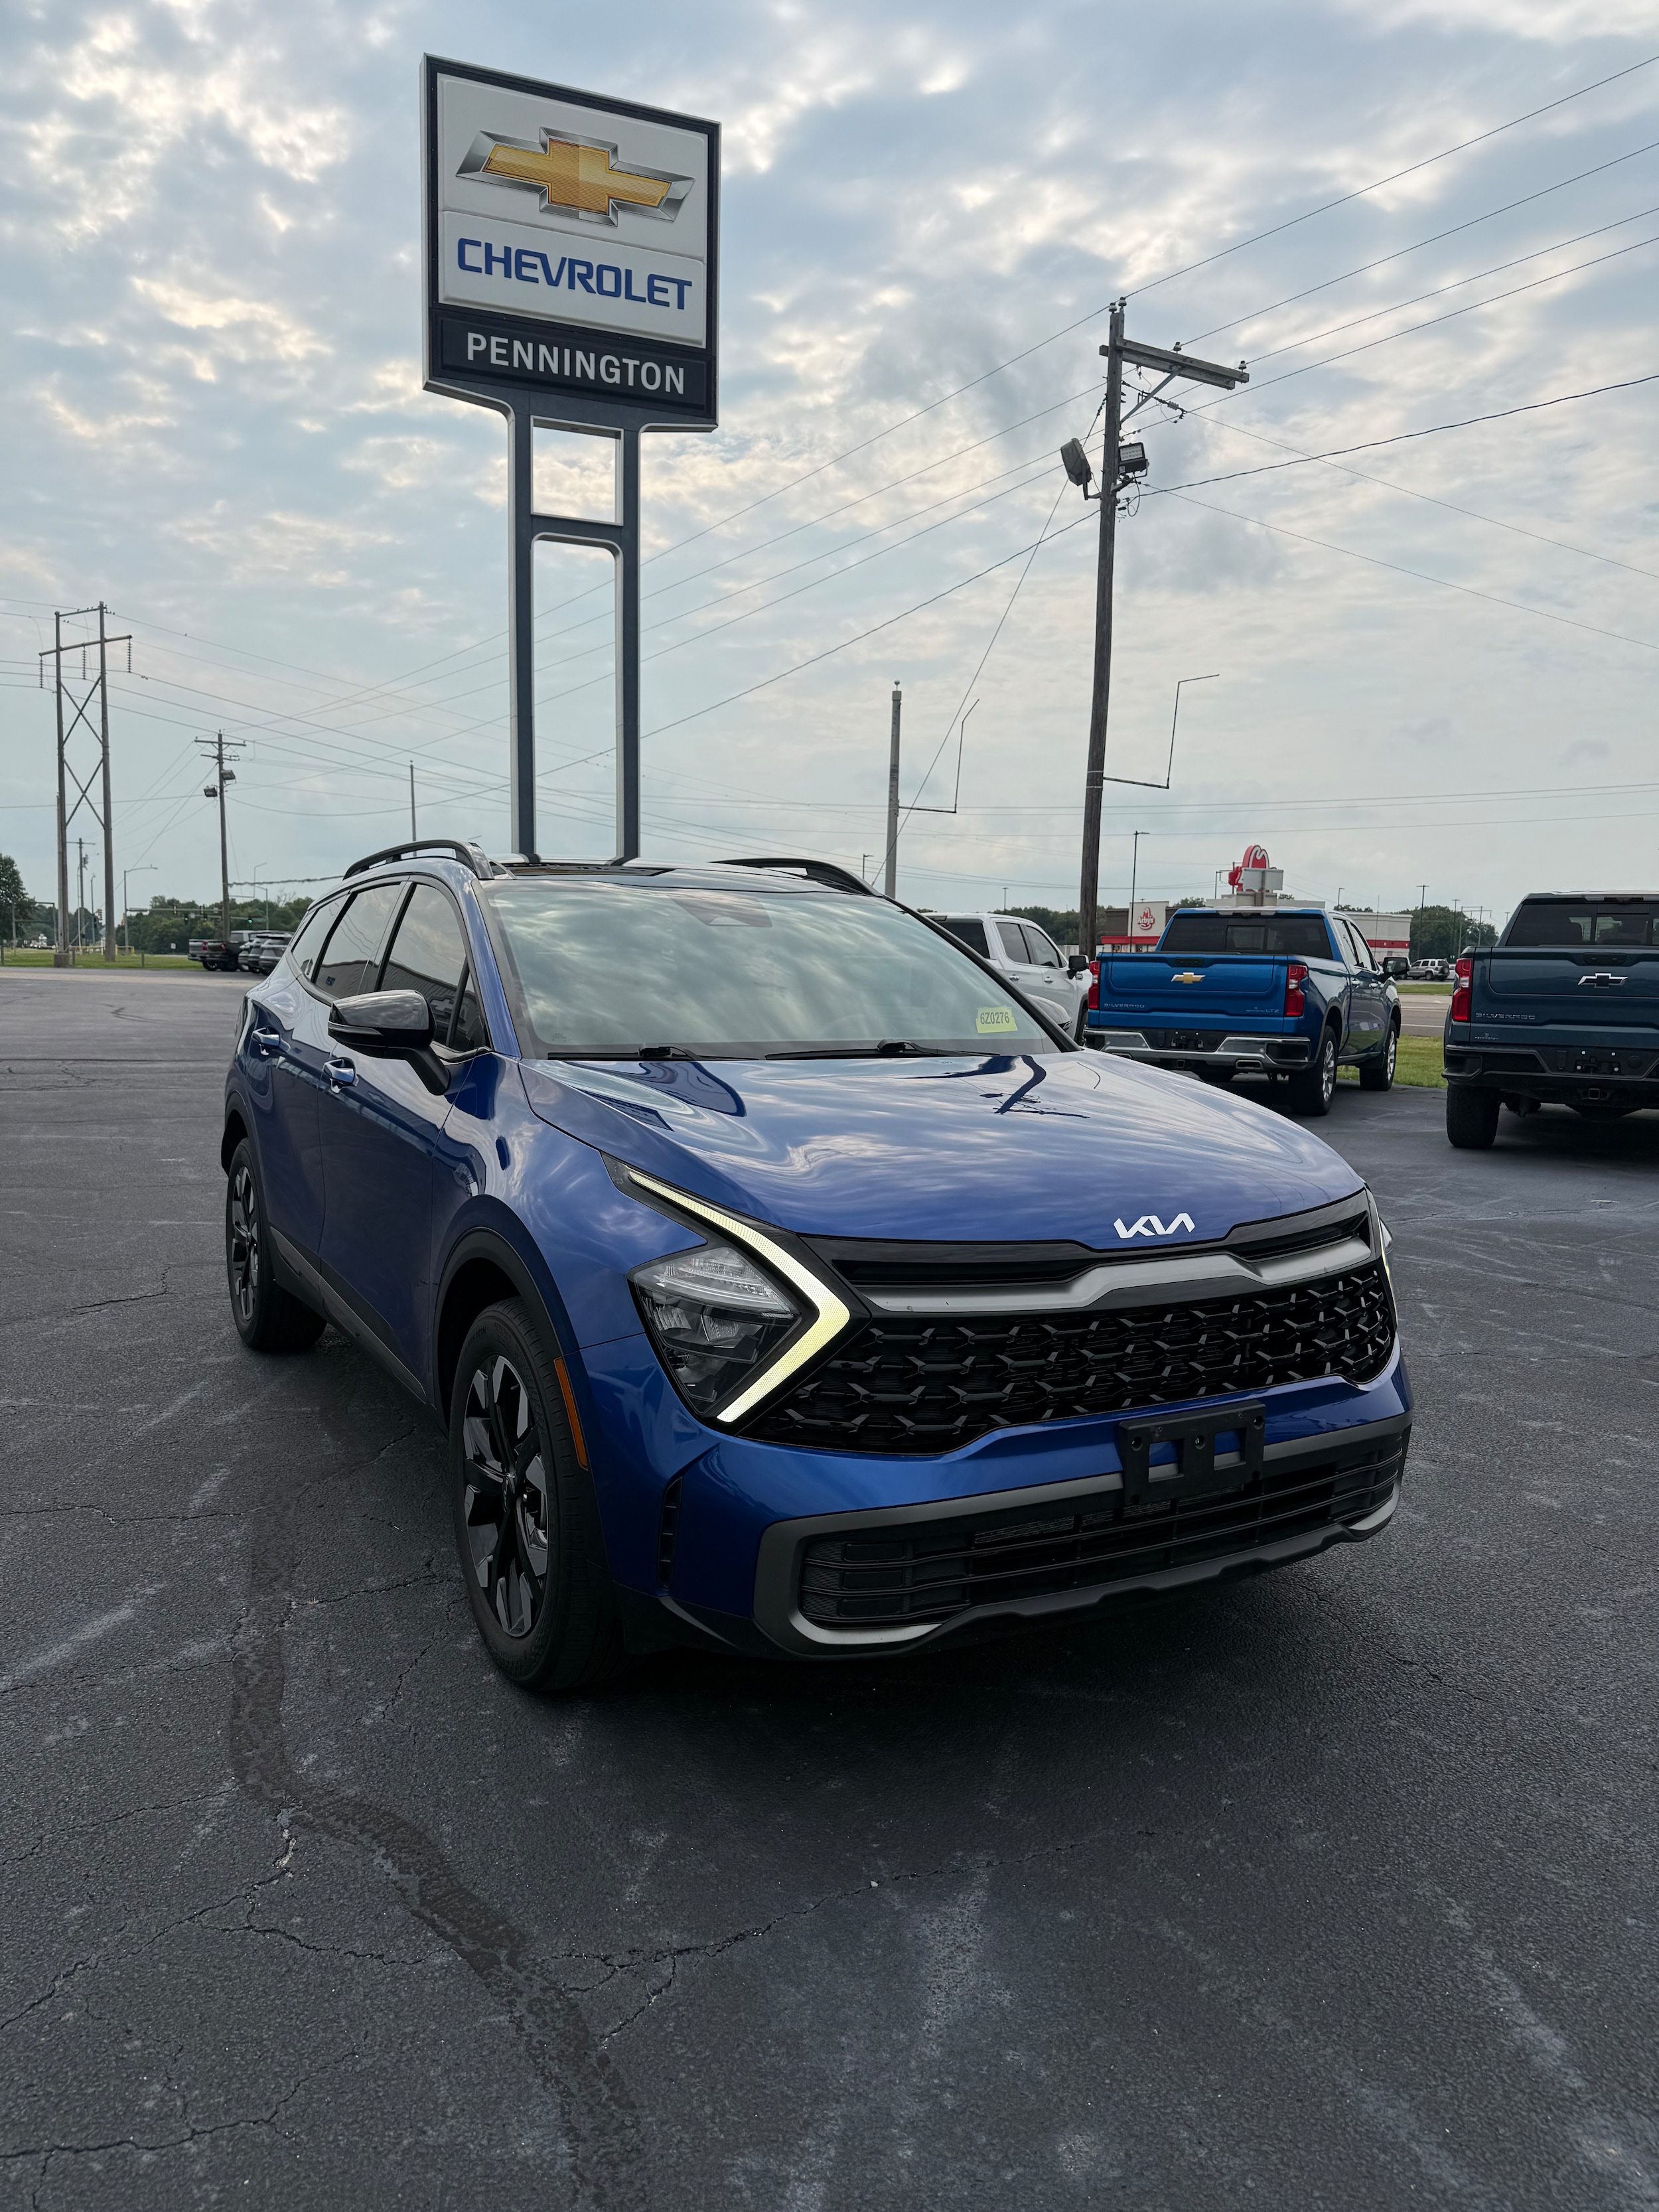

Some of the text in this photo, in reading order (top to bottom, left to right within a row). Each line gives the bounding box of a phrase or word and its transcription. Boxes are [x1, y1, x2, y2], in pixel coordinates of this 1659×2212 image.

[458, 237, 692, 310] CHEVROLET
[467, 332, 684, 394] PENNINGTON
[1137, 915, 1155, 925] Arby's
[980, 1011, 1009, 1025] 6Z0276
[1113, 1213, 1195, 1239] KIA
